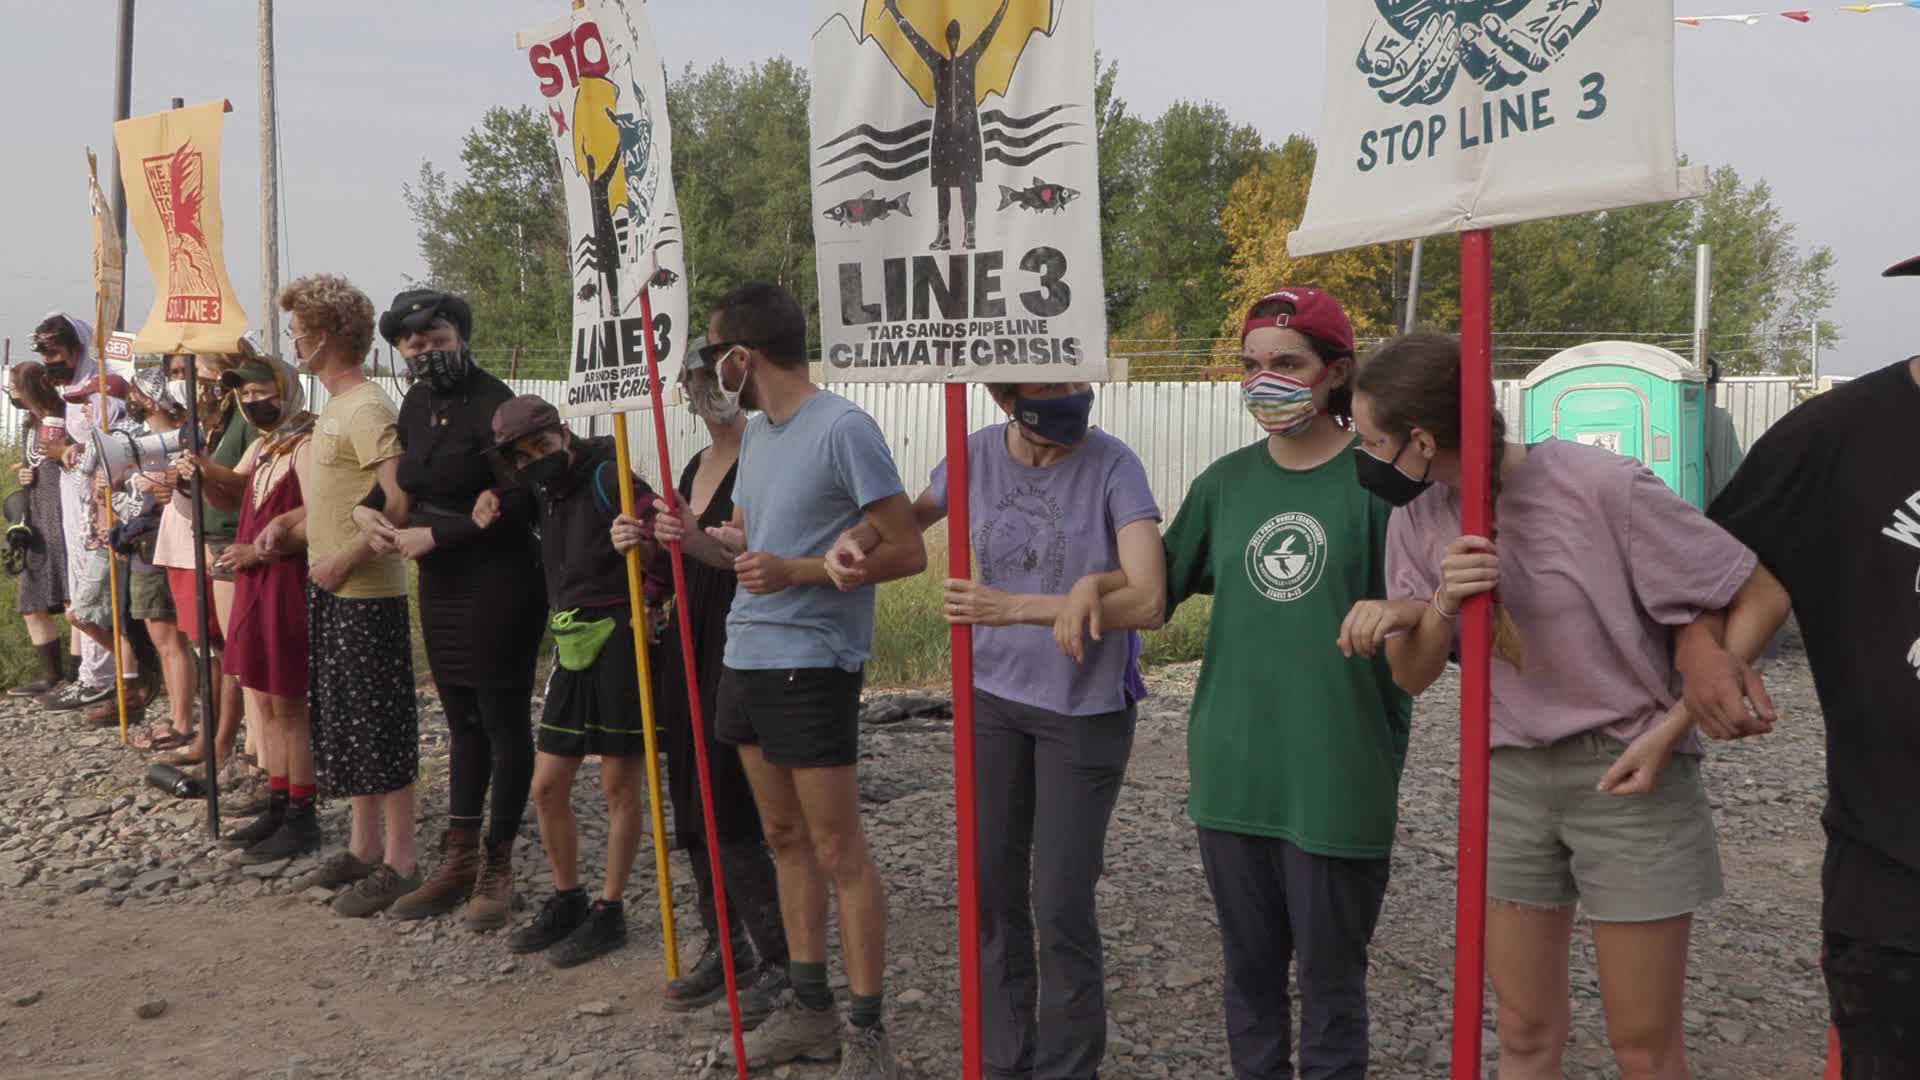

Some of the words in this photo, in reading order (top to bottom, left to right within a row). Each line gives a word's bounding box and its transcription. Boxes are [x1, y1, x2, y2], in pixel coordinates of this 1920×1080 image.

[1356, 114, 1446, 172] STOP
[1459, 88, 1555, 150] LINE
[1576, 72, 1608, 120] 3
[838, 250, 1007, 325] LINE
[1019, 246, 1072, 317] 3
[180, 299, 208, 321] INE
[211, 301, 220, 320] 3
[652, 313, 672, 362] 3
[868, 324, 903, 340] TAR
[906, 322, 966, 339] SANDS
[829, 340, 967, 369] CLIMATE
[970, 337, 1084, 367] CRISIS
[619, 376, 667, 399] CRISS
